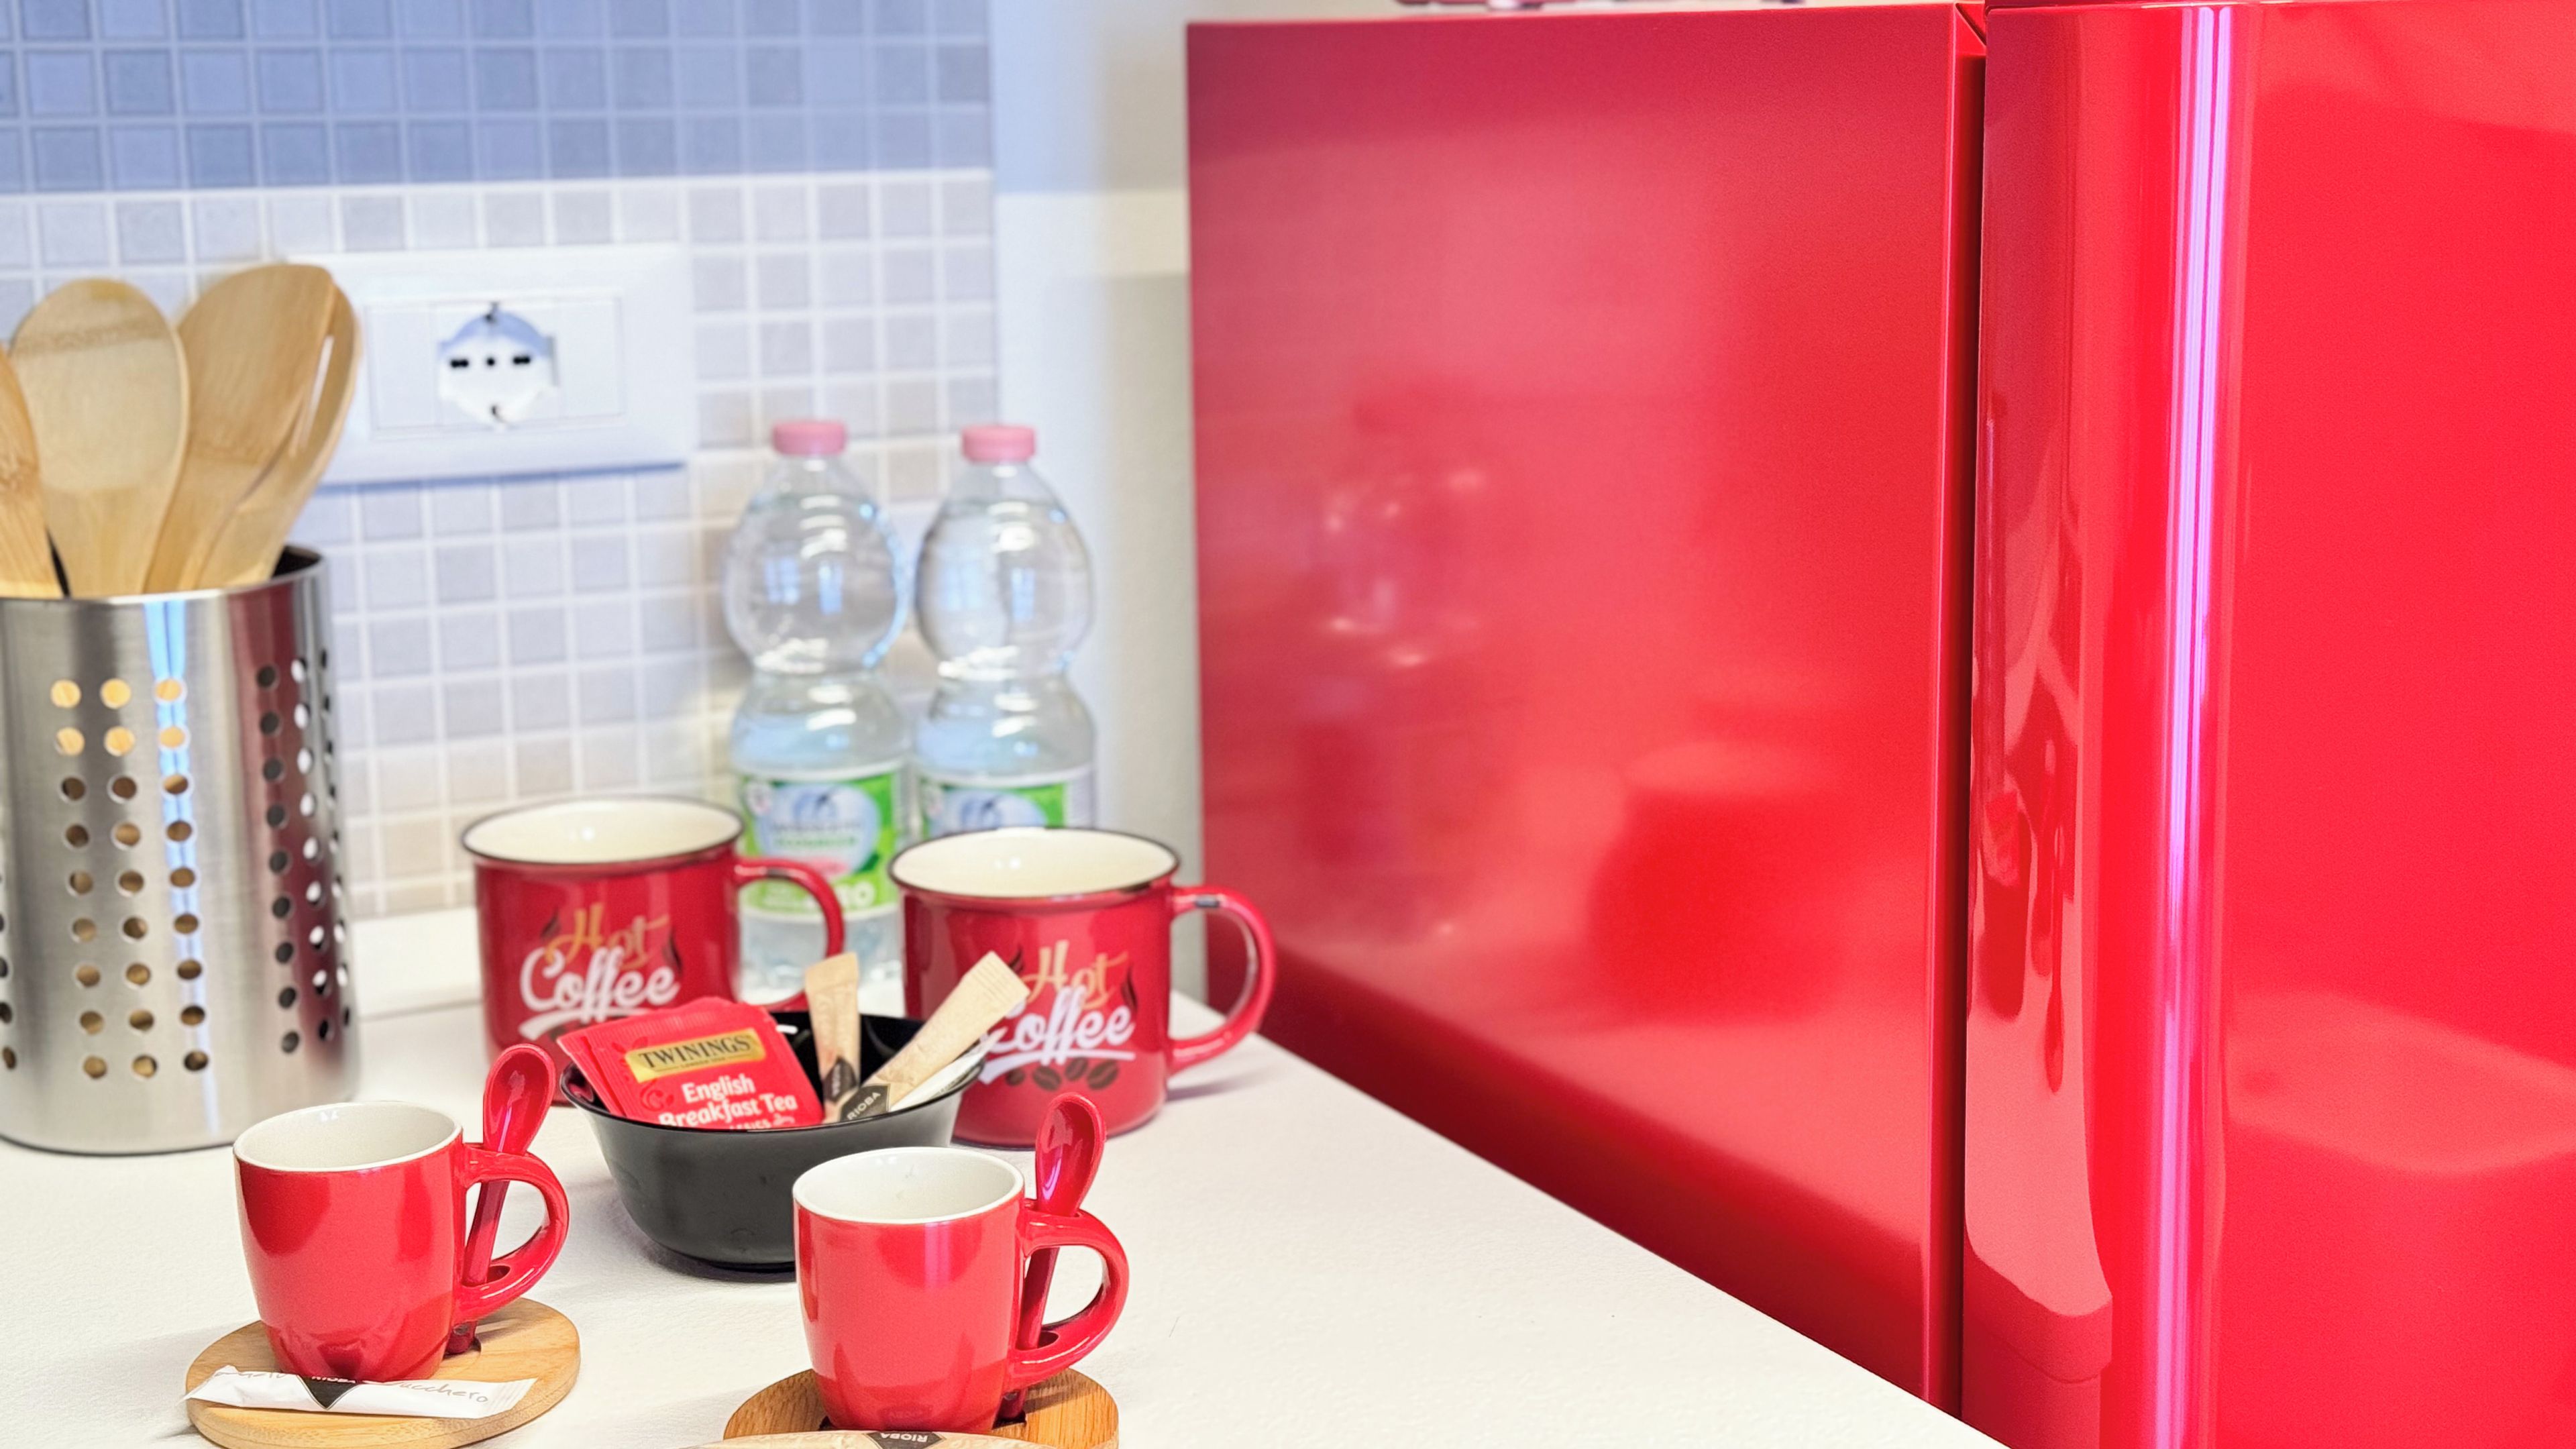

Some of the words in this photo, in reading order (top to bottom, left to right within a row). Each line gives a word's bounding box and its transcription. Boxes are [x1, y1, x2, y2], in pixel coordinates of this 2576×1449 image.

[544, 902, 670, 971] Hot
[519, 945, 680, 1024] Coffee
[1021, 940, 1129, 1010] Hot
[639, 1035, 751, 1069] TWININGS
[682, 1073, 756, 1103] English
[658, 1098, 762, 1128] Breakfast
[759, 1092, 799, 1113] Tea
[847, 1092, 881, 1120] RIOBA
[394, 1381, 489, 1403] ucchero
[880, 1432, 928, 1443] RIOBA
